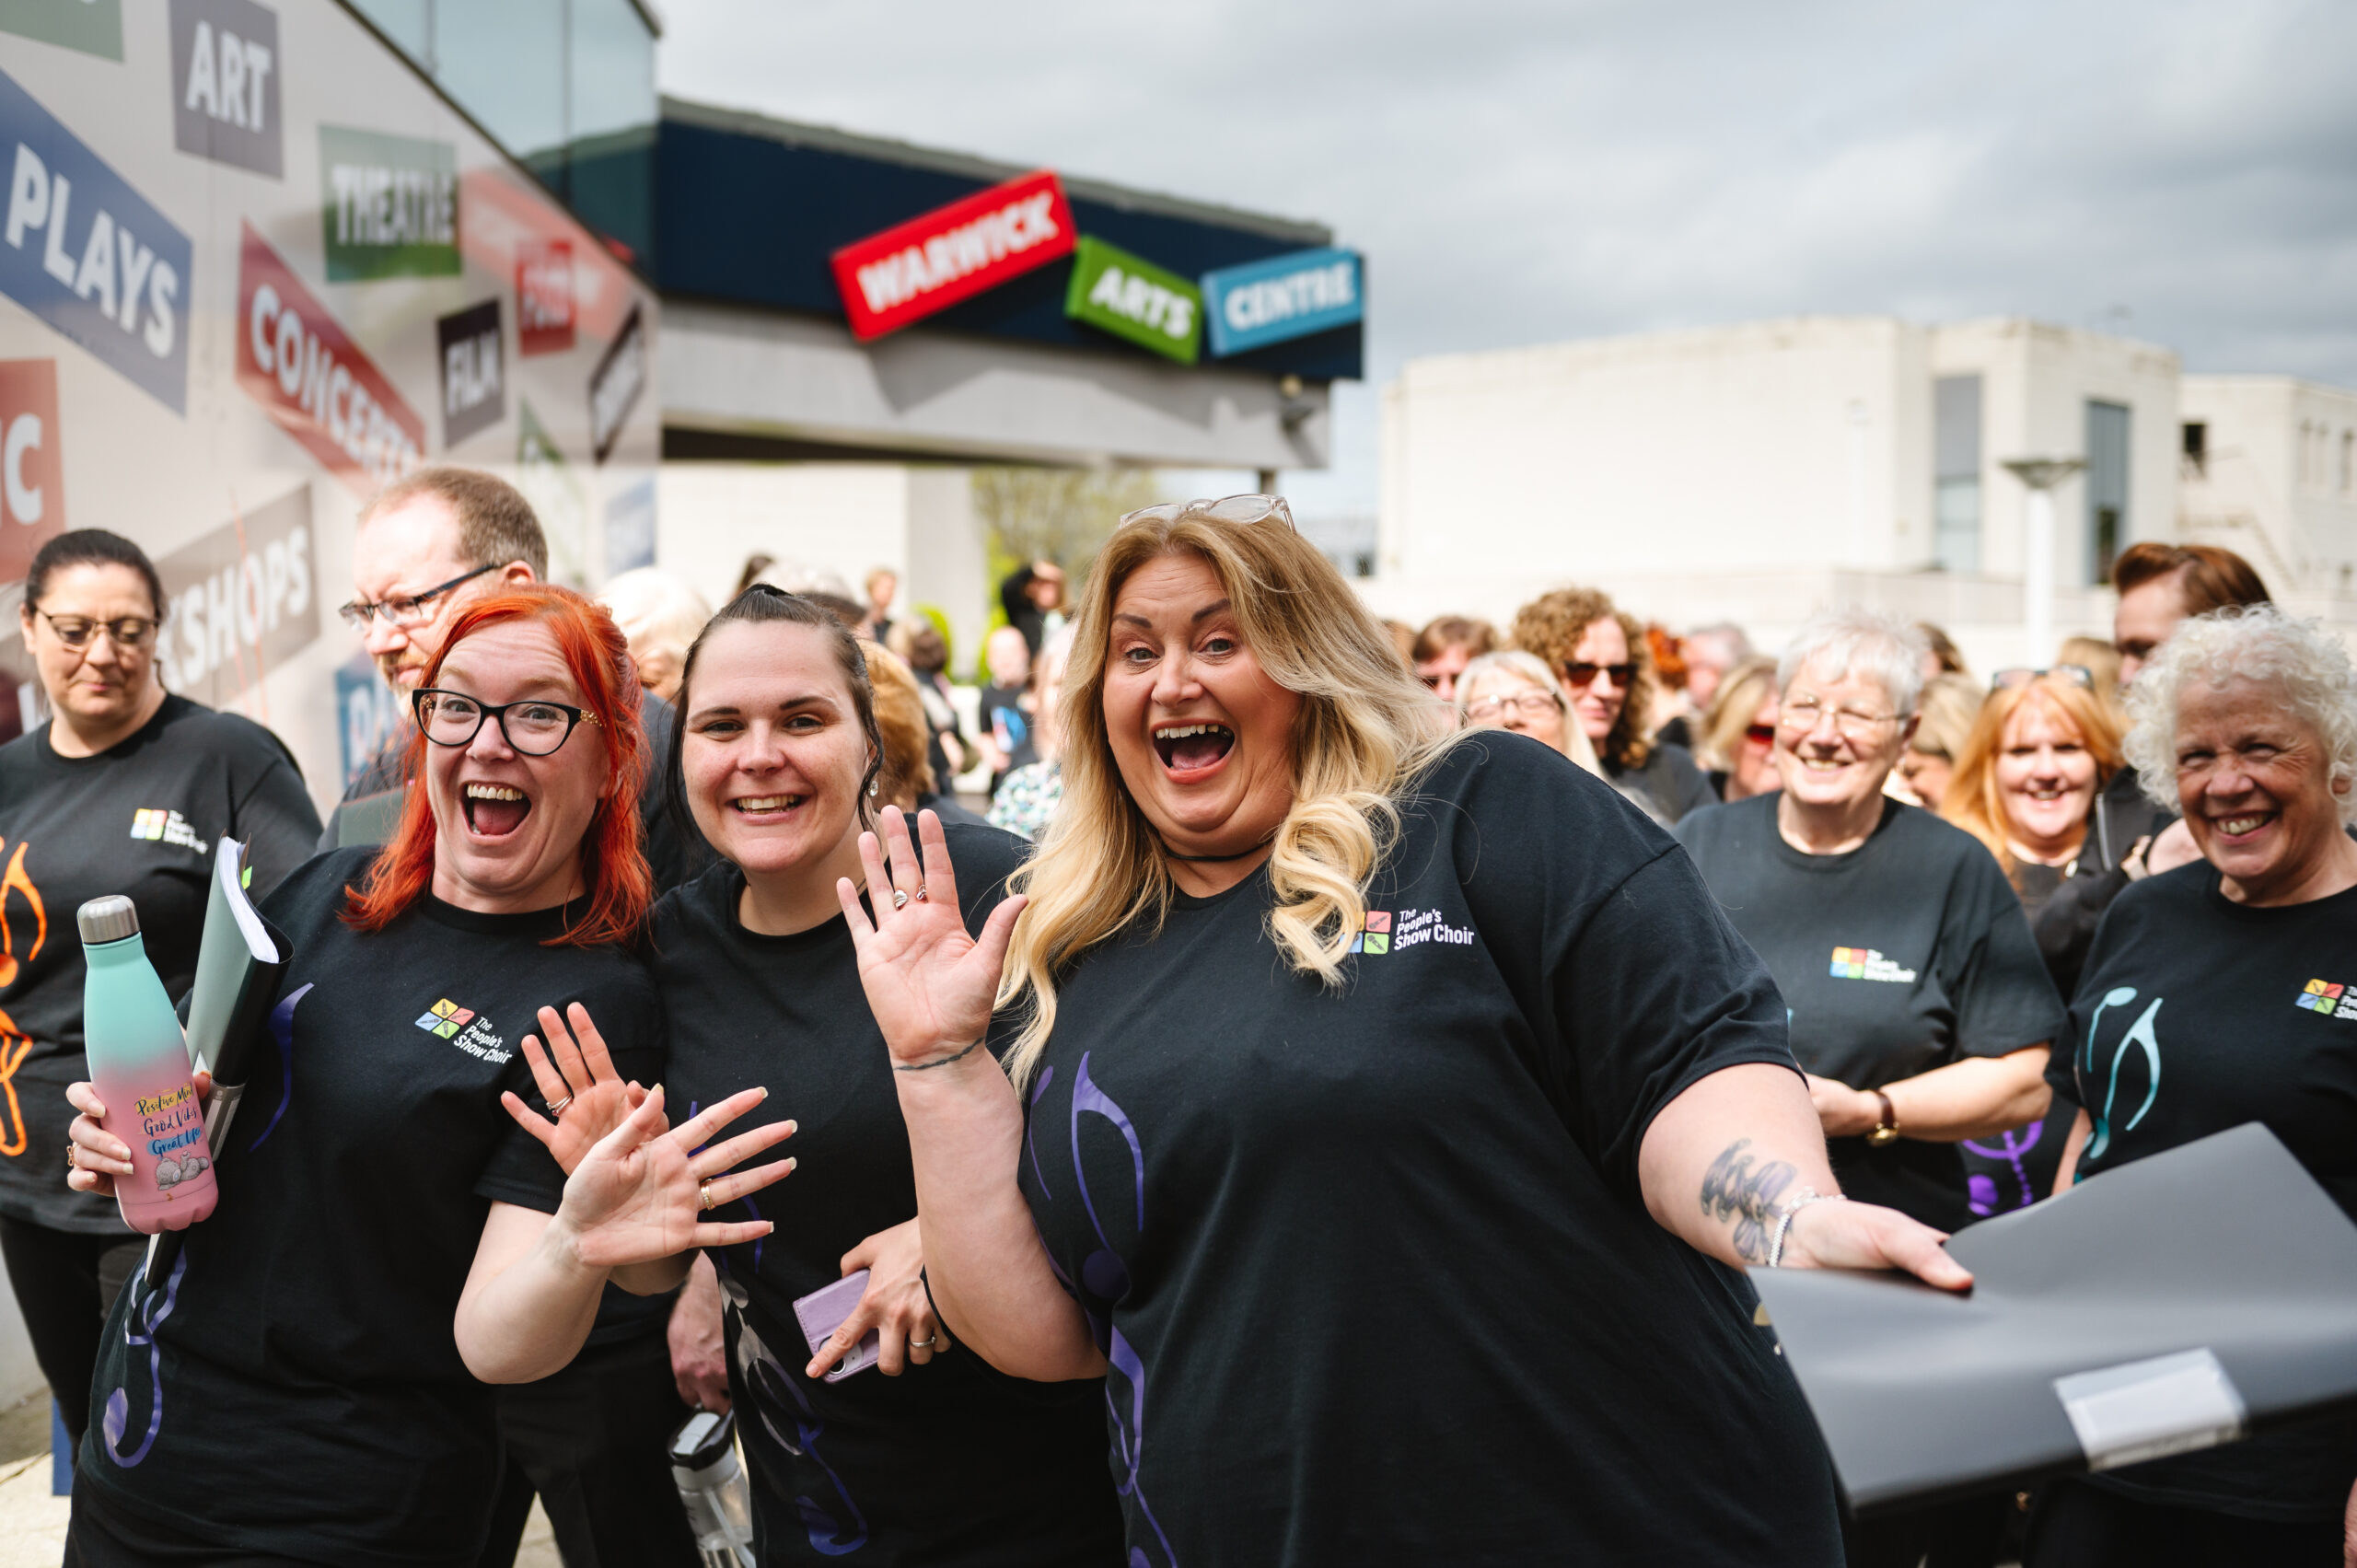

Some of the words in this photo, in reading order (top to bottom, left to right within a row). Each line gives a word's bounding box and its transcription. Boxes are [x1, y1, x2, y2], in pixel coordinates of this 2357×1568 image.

[186, 19, 272, 133] ART
[5, 140, 180, 358] PLAYS
[855, 191, 1059, 314] WARWICK
[1088, 265, 1194, 340] ARTS
[1224, 261, 1357, 332] CENTRE
[1396, 908, 1443, 936] People's
[1399, 908, 1417, 923] The
[1393, 927, 1433, 950] Show
[1433, 923, 1475, 946] Choir
[464, 1025, 503, 1048] People's
[475, 1016, 493, 1031] The
[453, 1034, 488, 1058] Show
[482, 1048, 514, 1064] Choir
[134, 1095, 175, 1117] Positive
[144, 1115, 175, 1137] Good
[176, 1107, 197, 1128] Vibes
[152, 1134, 182, 1157] Great
[185, 1127, 200, 1145] Life
